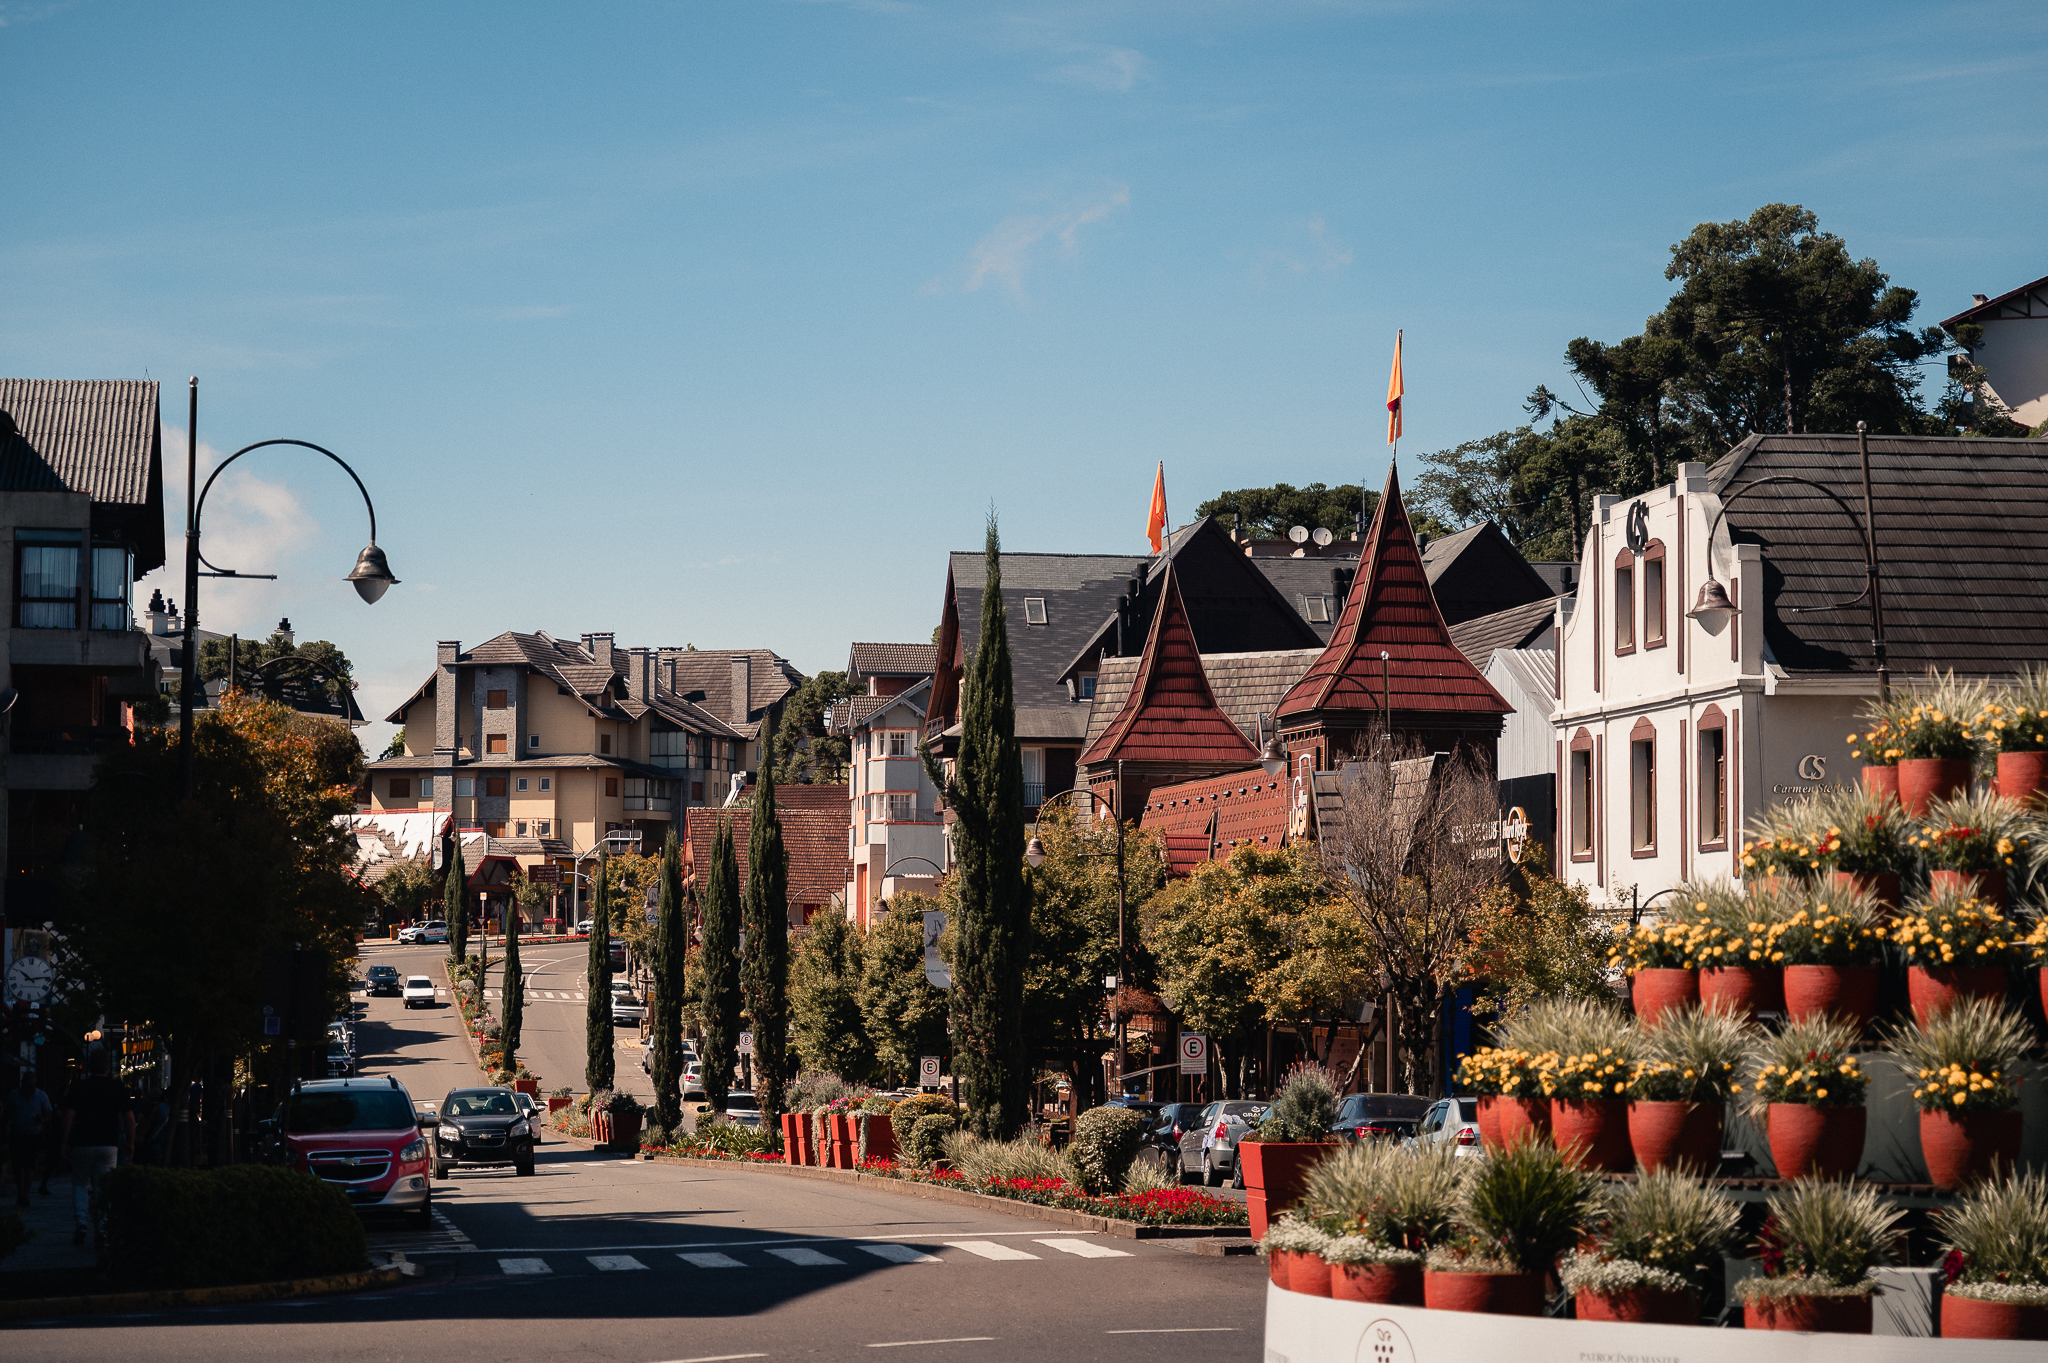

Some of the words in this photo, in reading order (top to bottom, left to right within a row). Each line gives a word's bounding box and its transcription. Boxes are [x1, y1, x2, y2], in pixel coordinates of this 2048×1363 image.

[1799, 754, 1827, 780] CS
[1773, 783, 1814, 794] Carmen
[1189, 1041, 1198, 1054] E
[927, 1062, 933, 1072] E
[1134, 1085, 1140, 1093] P
